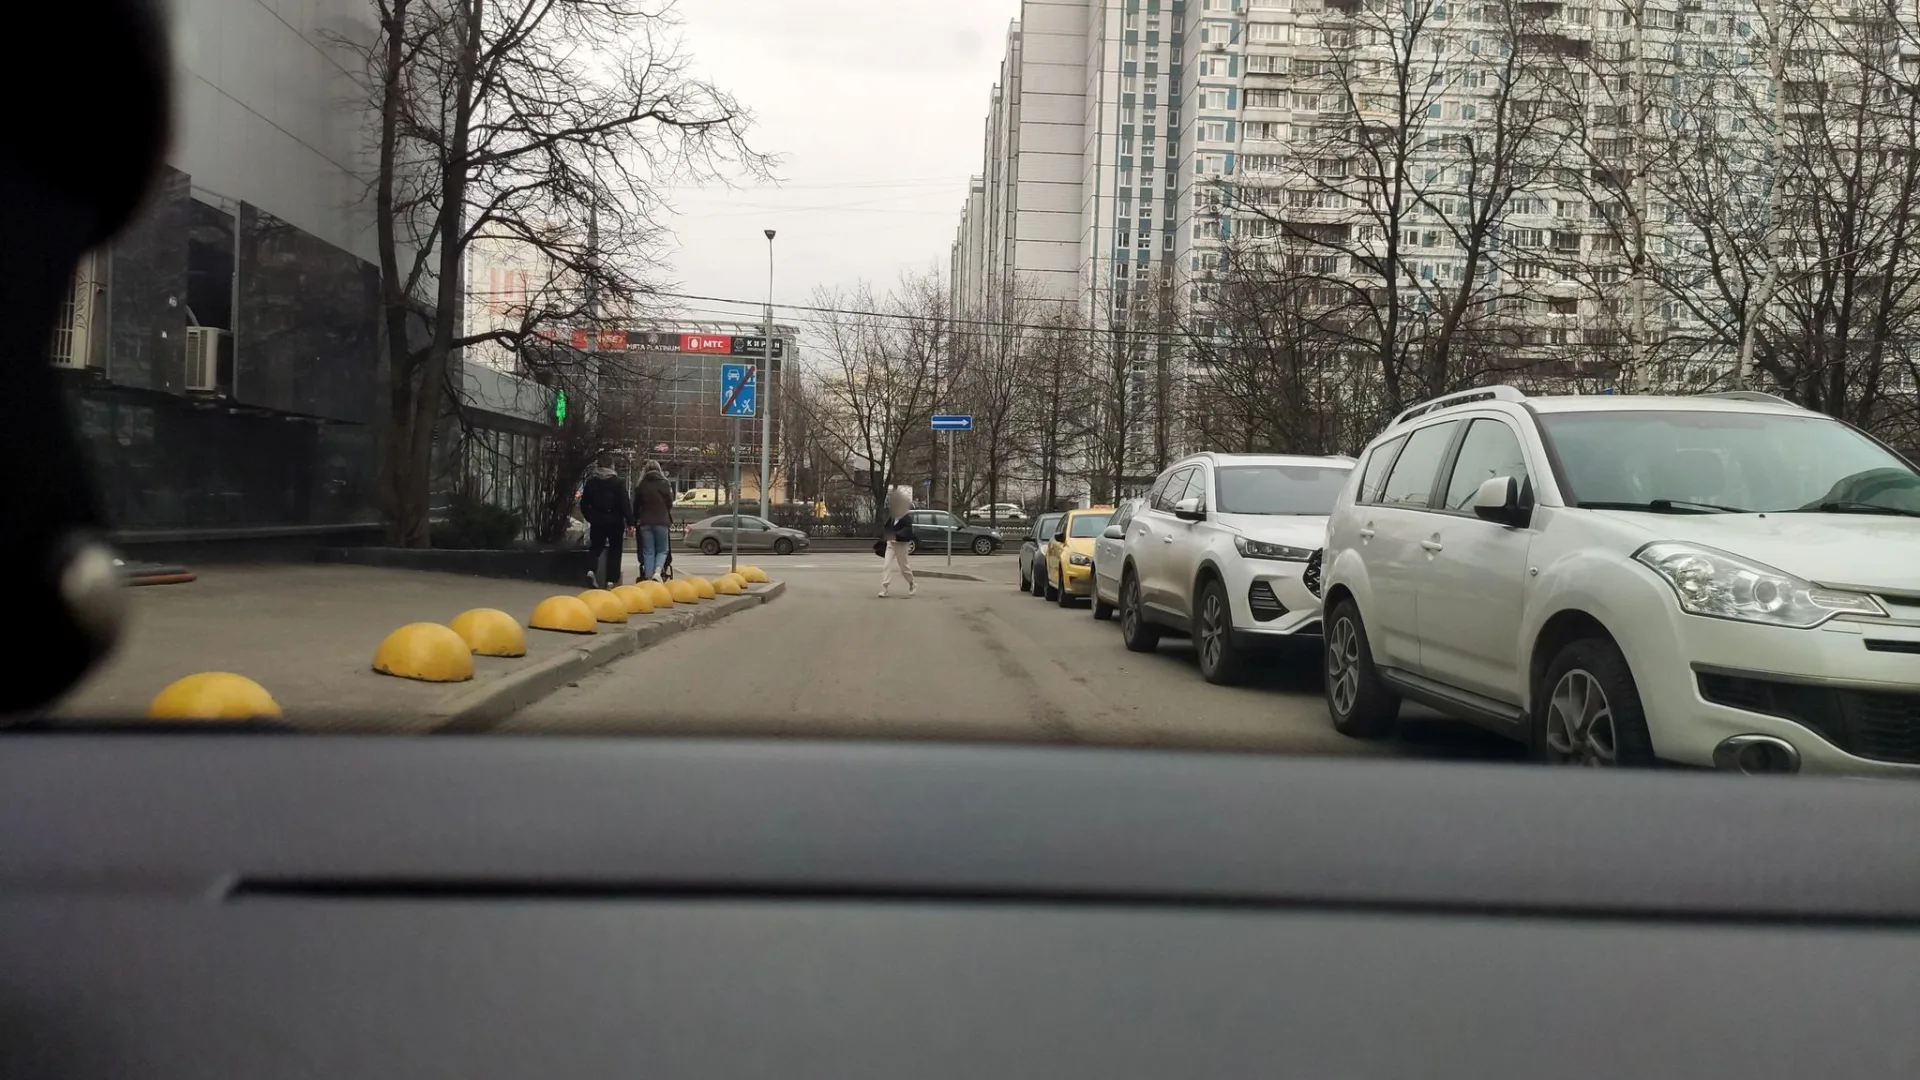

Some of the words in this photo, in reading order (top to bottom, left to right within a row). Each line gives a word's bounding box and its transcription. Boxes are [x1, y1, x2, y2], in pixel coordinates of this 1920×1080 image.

[646, 344, 681, 352] PLATINUM
[703, 339, 724, 349] МТС
[746, 340, 780, 348] КИРН
